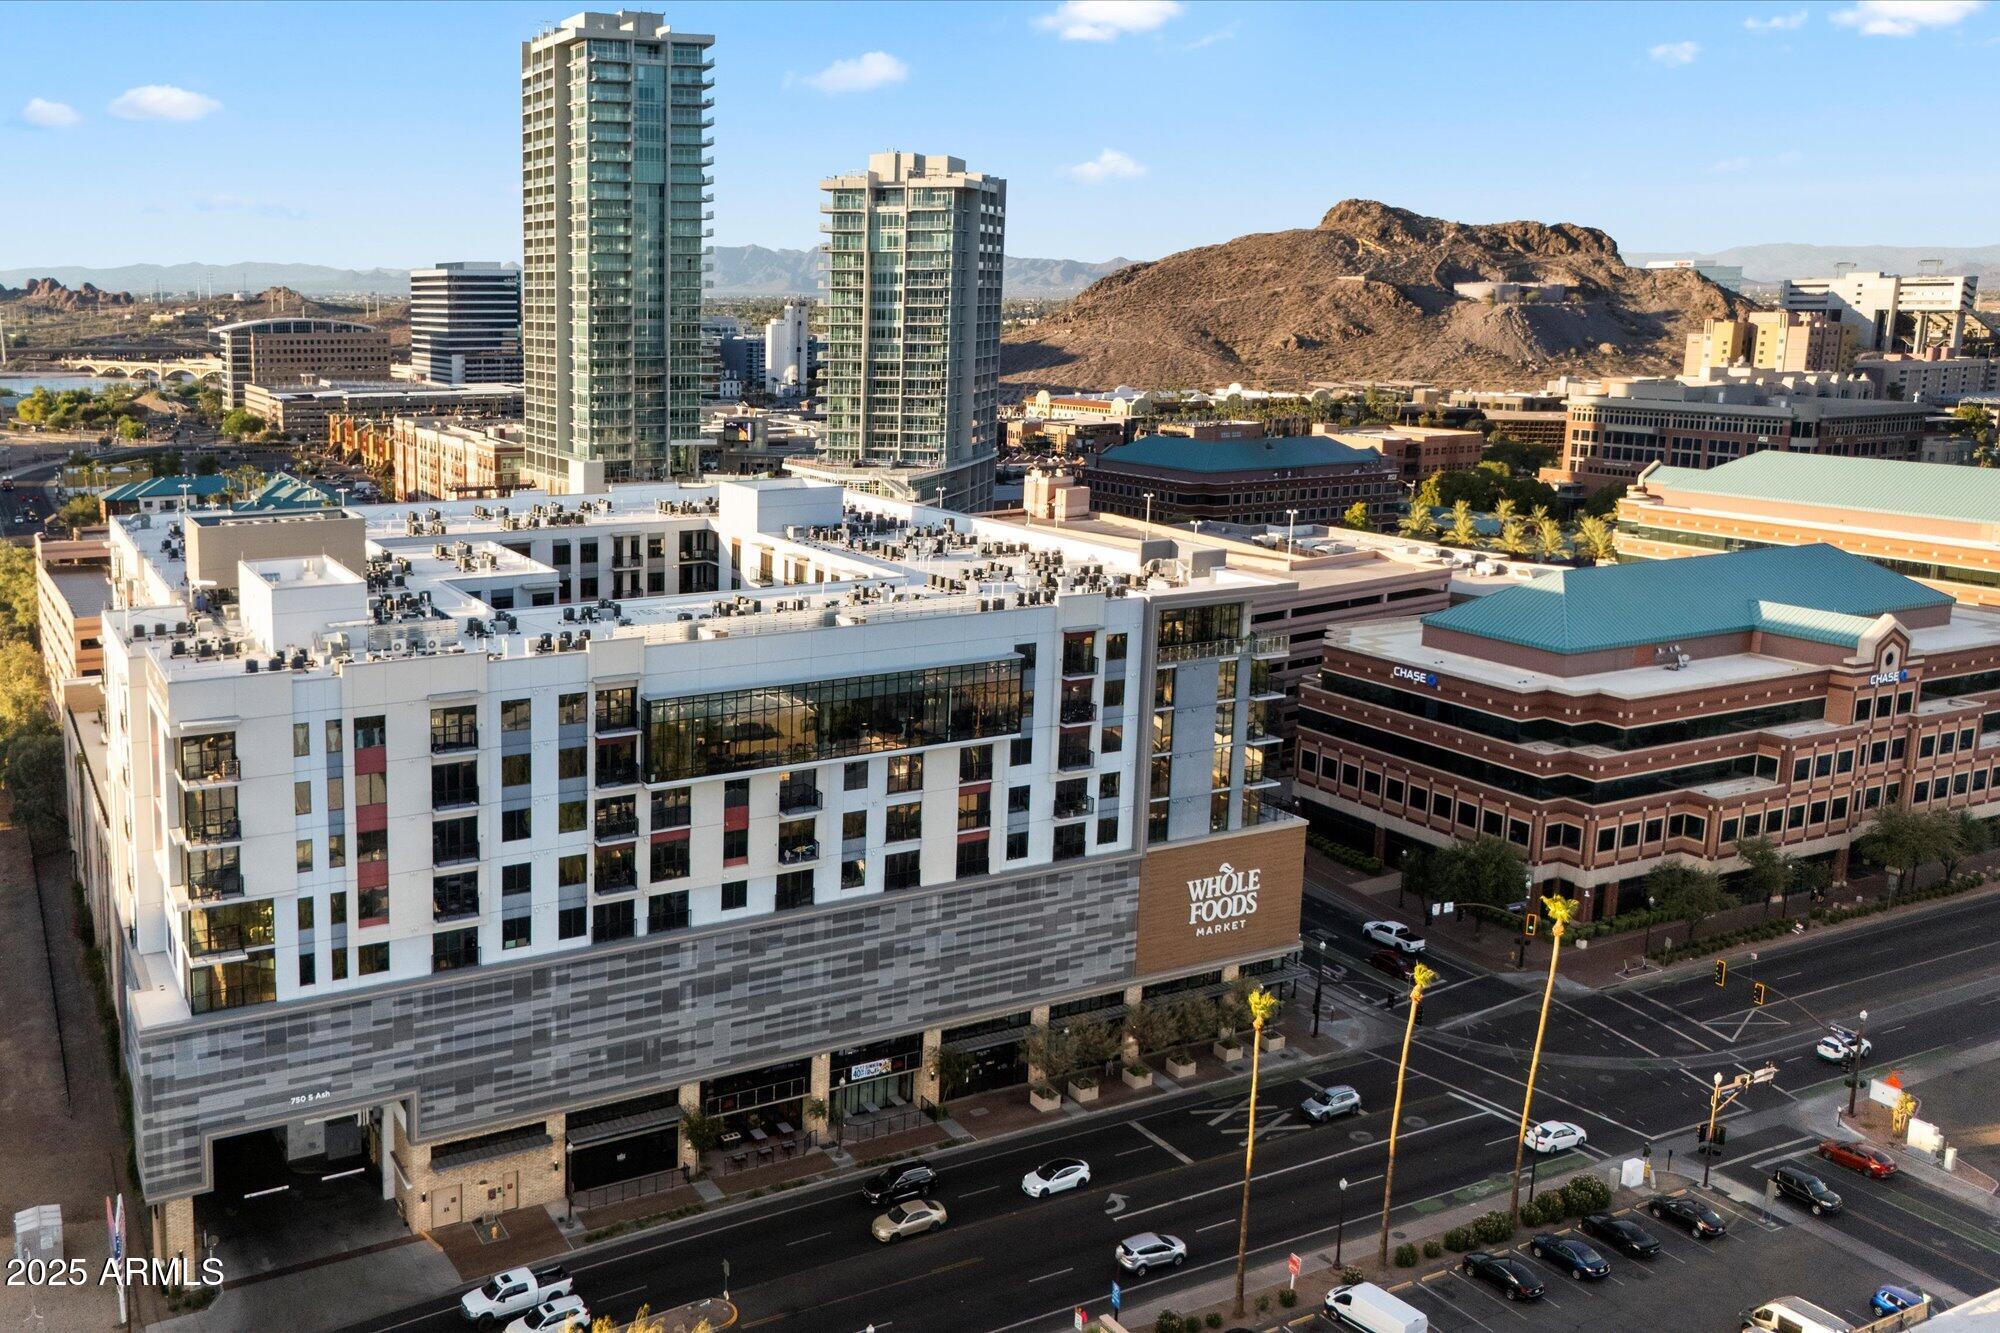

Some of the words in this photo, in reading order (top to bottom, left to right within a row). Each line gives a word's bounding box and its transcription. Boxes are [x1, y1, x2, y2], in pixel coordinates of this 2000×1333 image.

[1393, 666, 1427, 683] CHASE
[1870, 671, 1900, 685] CHASE
[1186, 866, 1261, 902] WHOLE
[1188, 891, 1258, 925] FOODS
[1195, 919, 1247, 937] MARKET
[290, 1095, 307, 1105] 750
[308, 1093, 314, 1101] S
[315, 1090, 331, 1100] Ash
